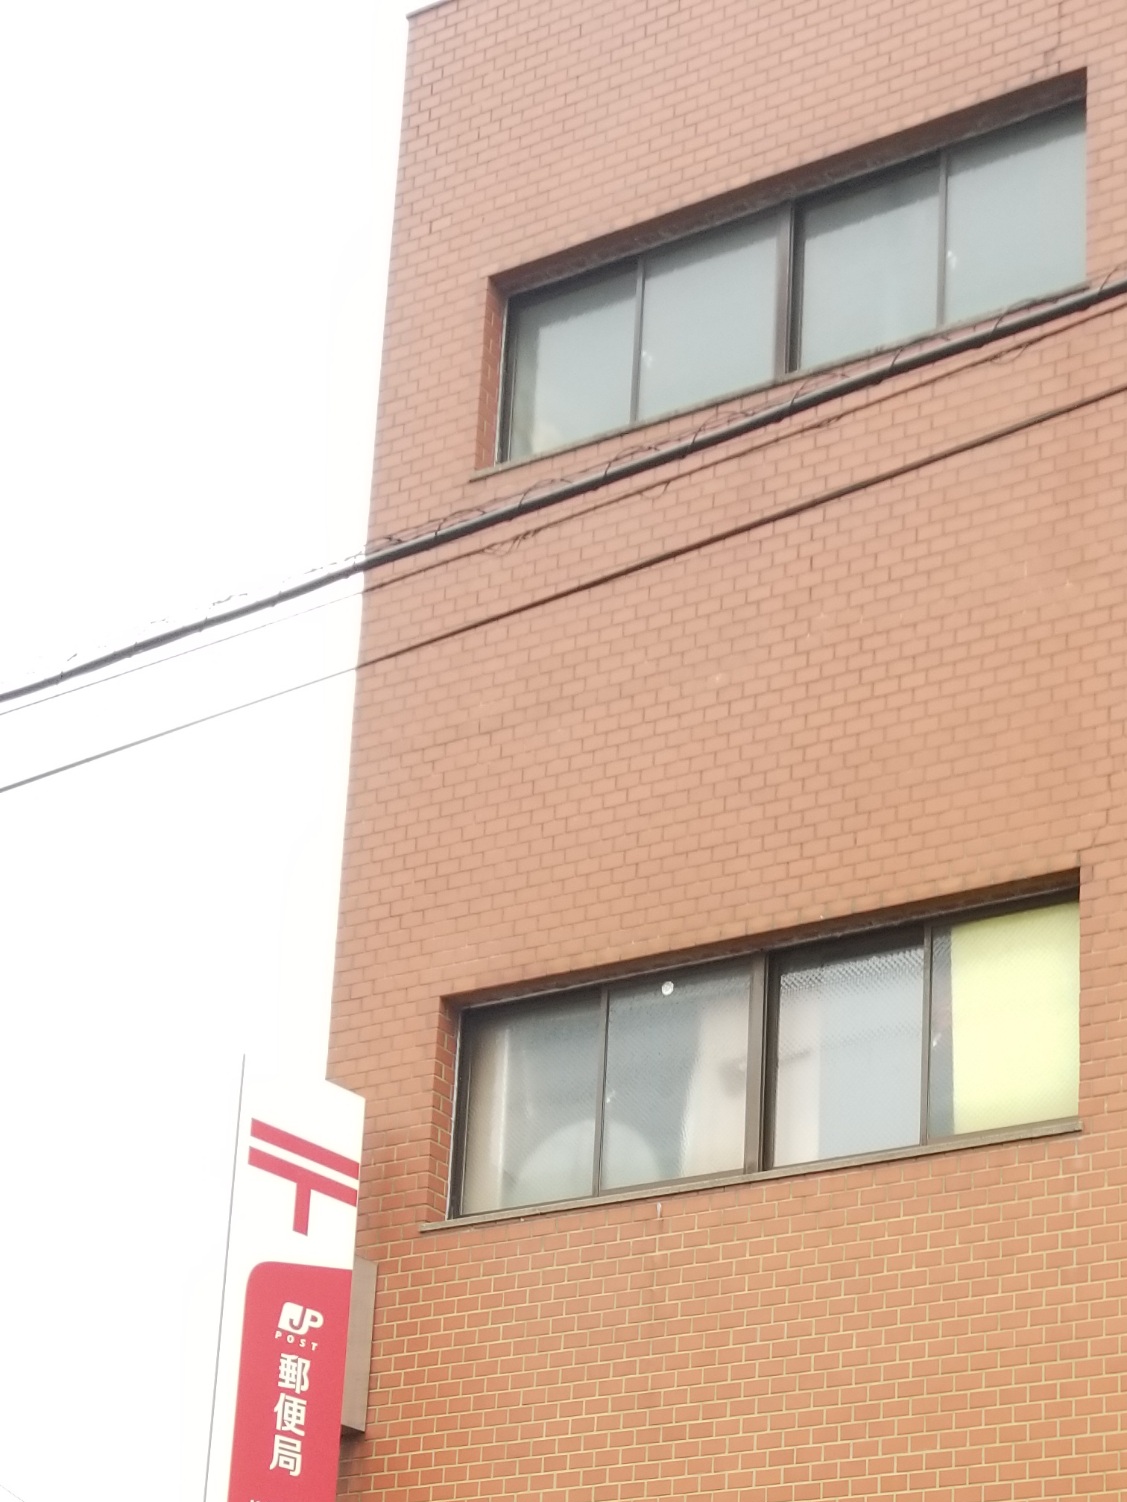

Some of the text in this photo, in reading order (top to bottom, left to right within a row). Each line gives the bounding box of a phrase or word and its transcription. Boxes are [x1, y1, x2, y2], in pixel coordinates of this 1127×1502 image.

[275, 1331, 318, 1351] POST
[270, 1353, 310, 1477] 郵便局
